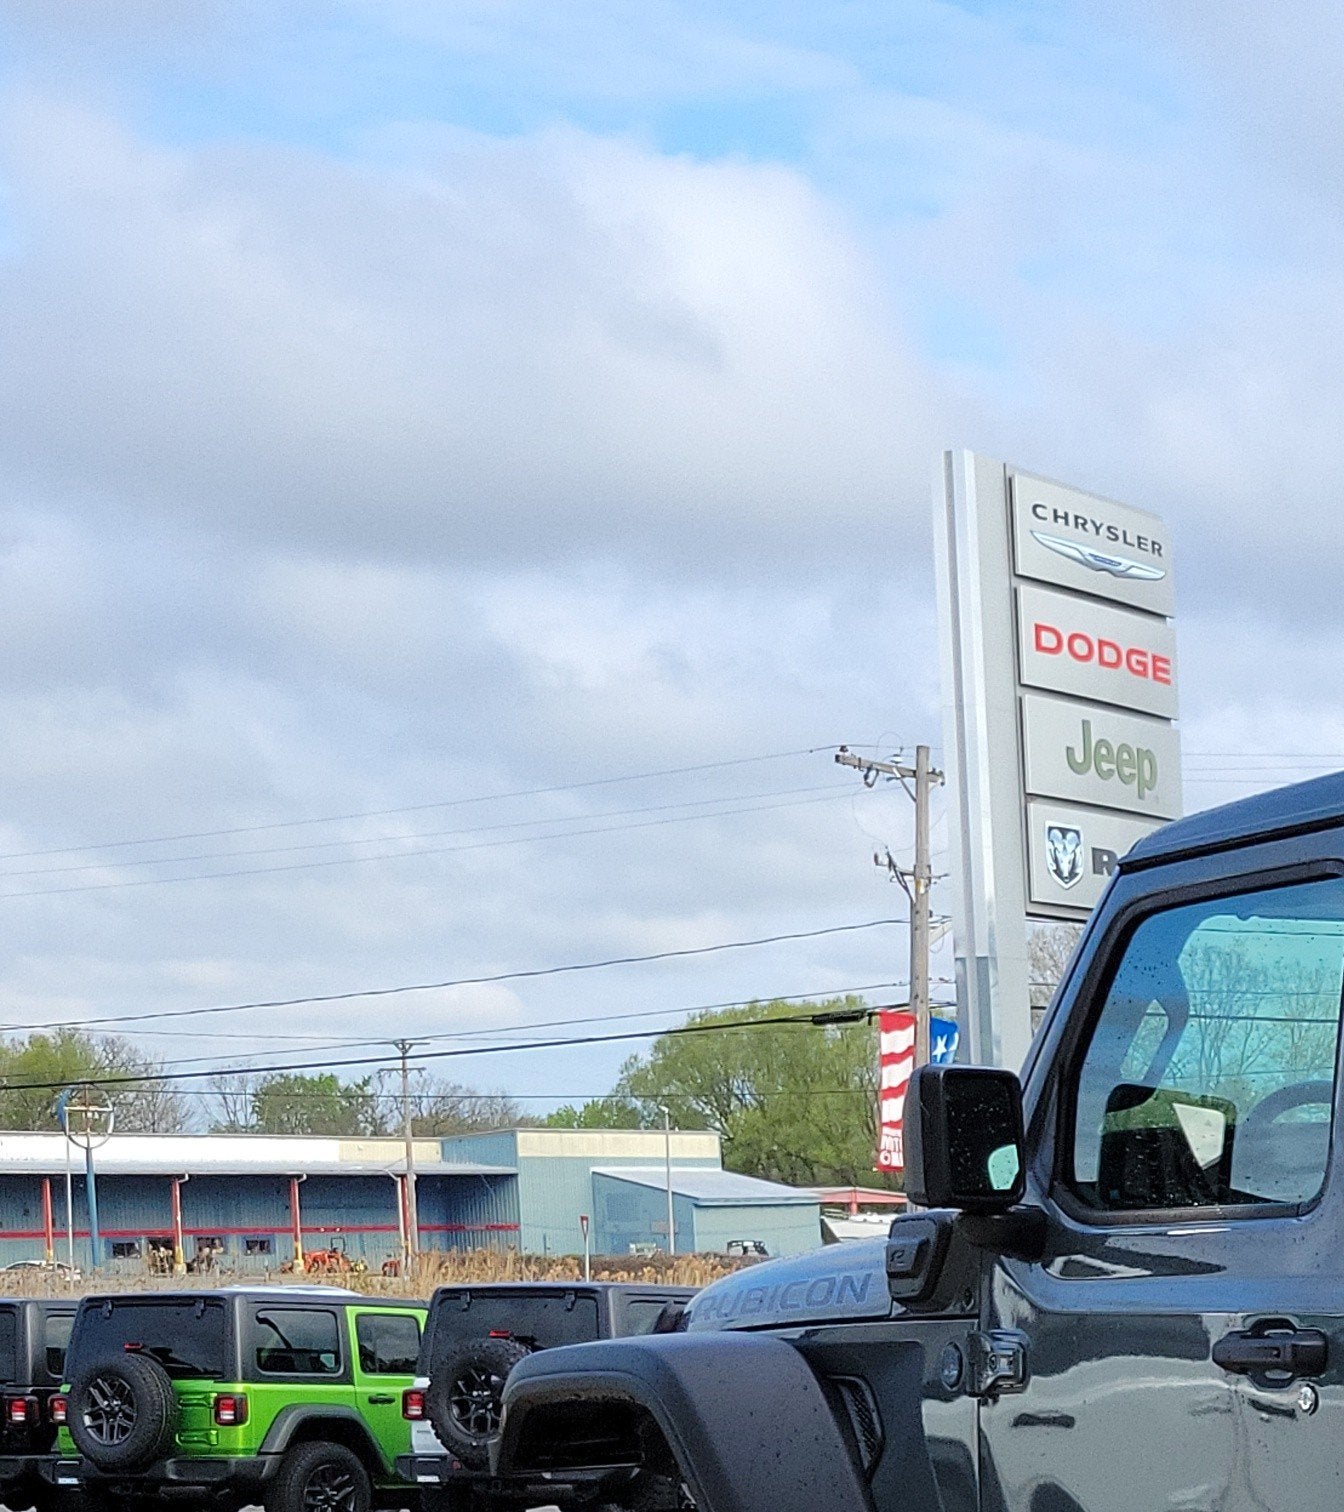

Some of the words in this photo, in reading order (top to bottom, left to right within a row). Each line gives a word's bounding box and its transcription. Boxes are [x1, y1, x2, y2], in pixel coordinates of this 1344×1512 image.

[1031, 502, 1164, 558] CHRYSLER
[1033, 621, 1172, 686] DODGE
[1065, 719, 1158, 800] Jeep
[693, 1272, 873, 1323] RUBICON
